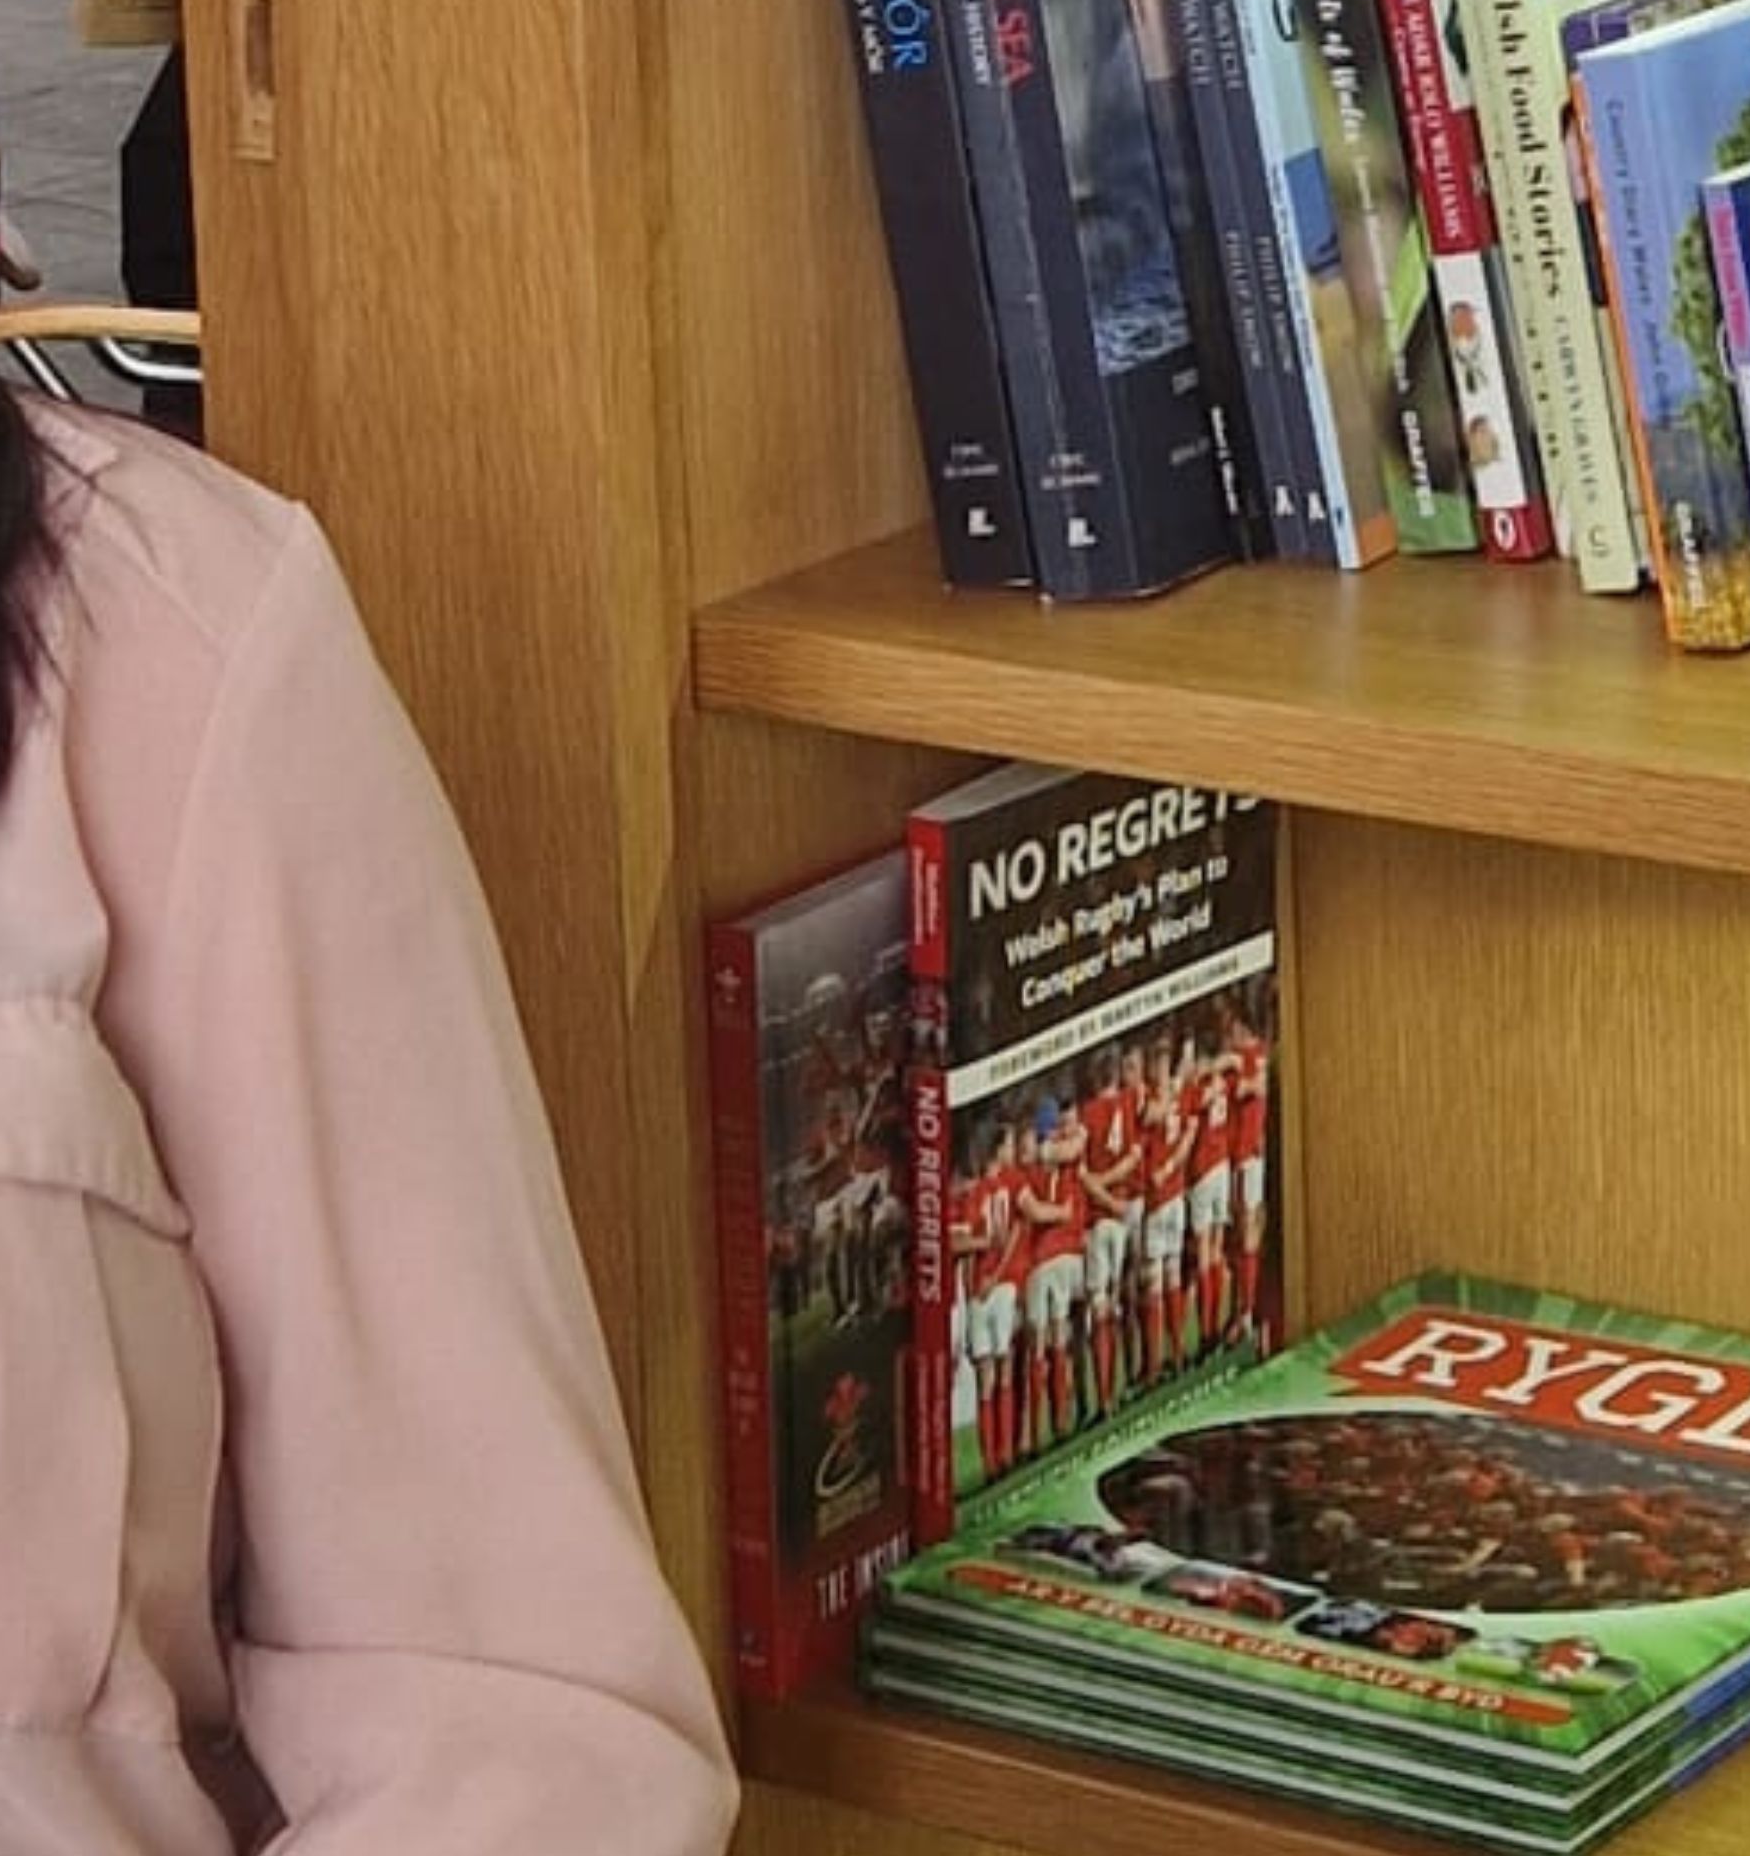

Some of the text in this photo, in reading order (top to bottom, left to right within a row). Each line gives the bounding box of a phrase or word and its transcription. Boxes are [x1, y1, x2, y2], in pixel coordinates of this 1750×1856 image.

[993, 6, 1036, 89] SEA
[1320, 27, 1356, 61] of
[1328, 66, 1370, 145] Wales
[1503, 63, 1547, 155] Food
[1426, 128, 1467, 240] WILLIAMS
[1520, 159, 1571, 300] Stories
[968, 839, 1046, 919] NO
[1004, 855, 1229, 968] Welsh Rugby's Plan to
[1020, 898, 1213, 1008] Conquer the World
[914, 1085, 942, 1304] NO REGRETS
